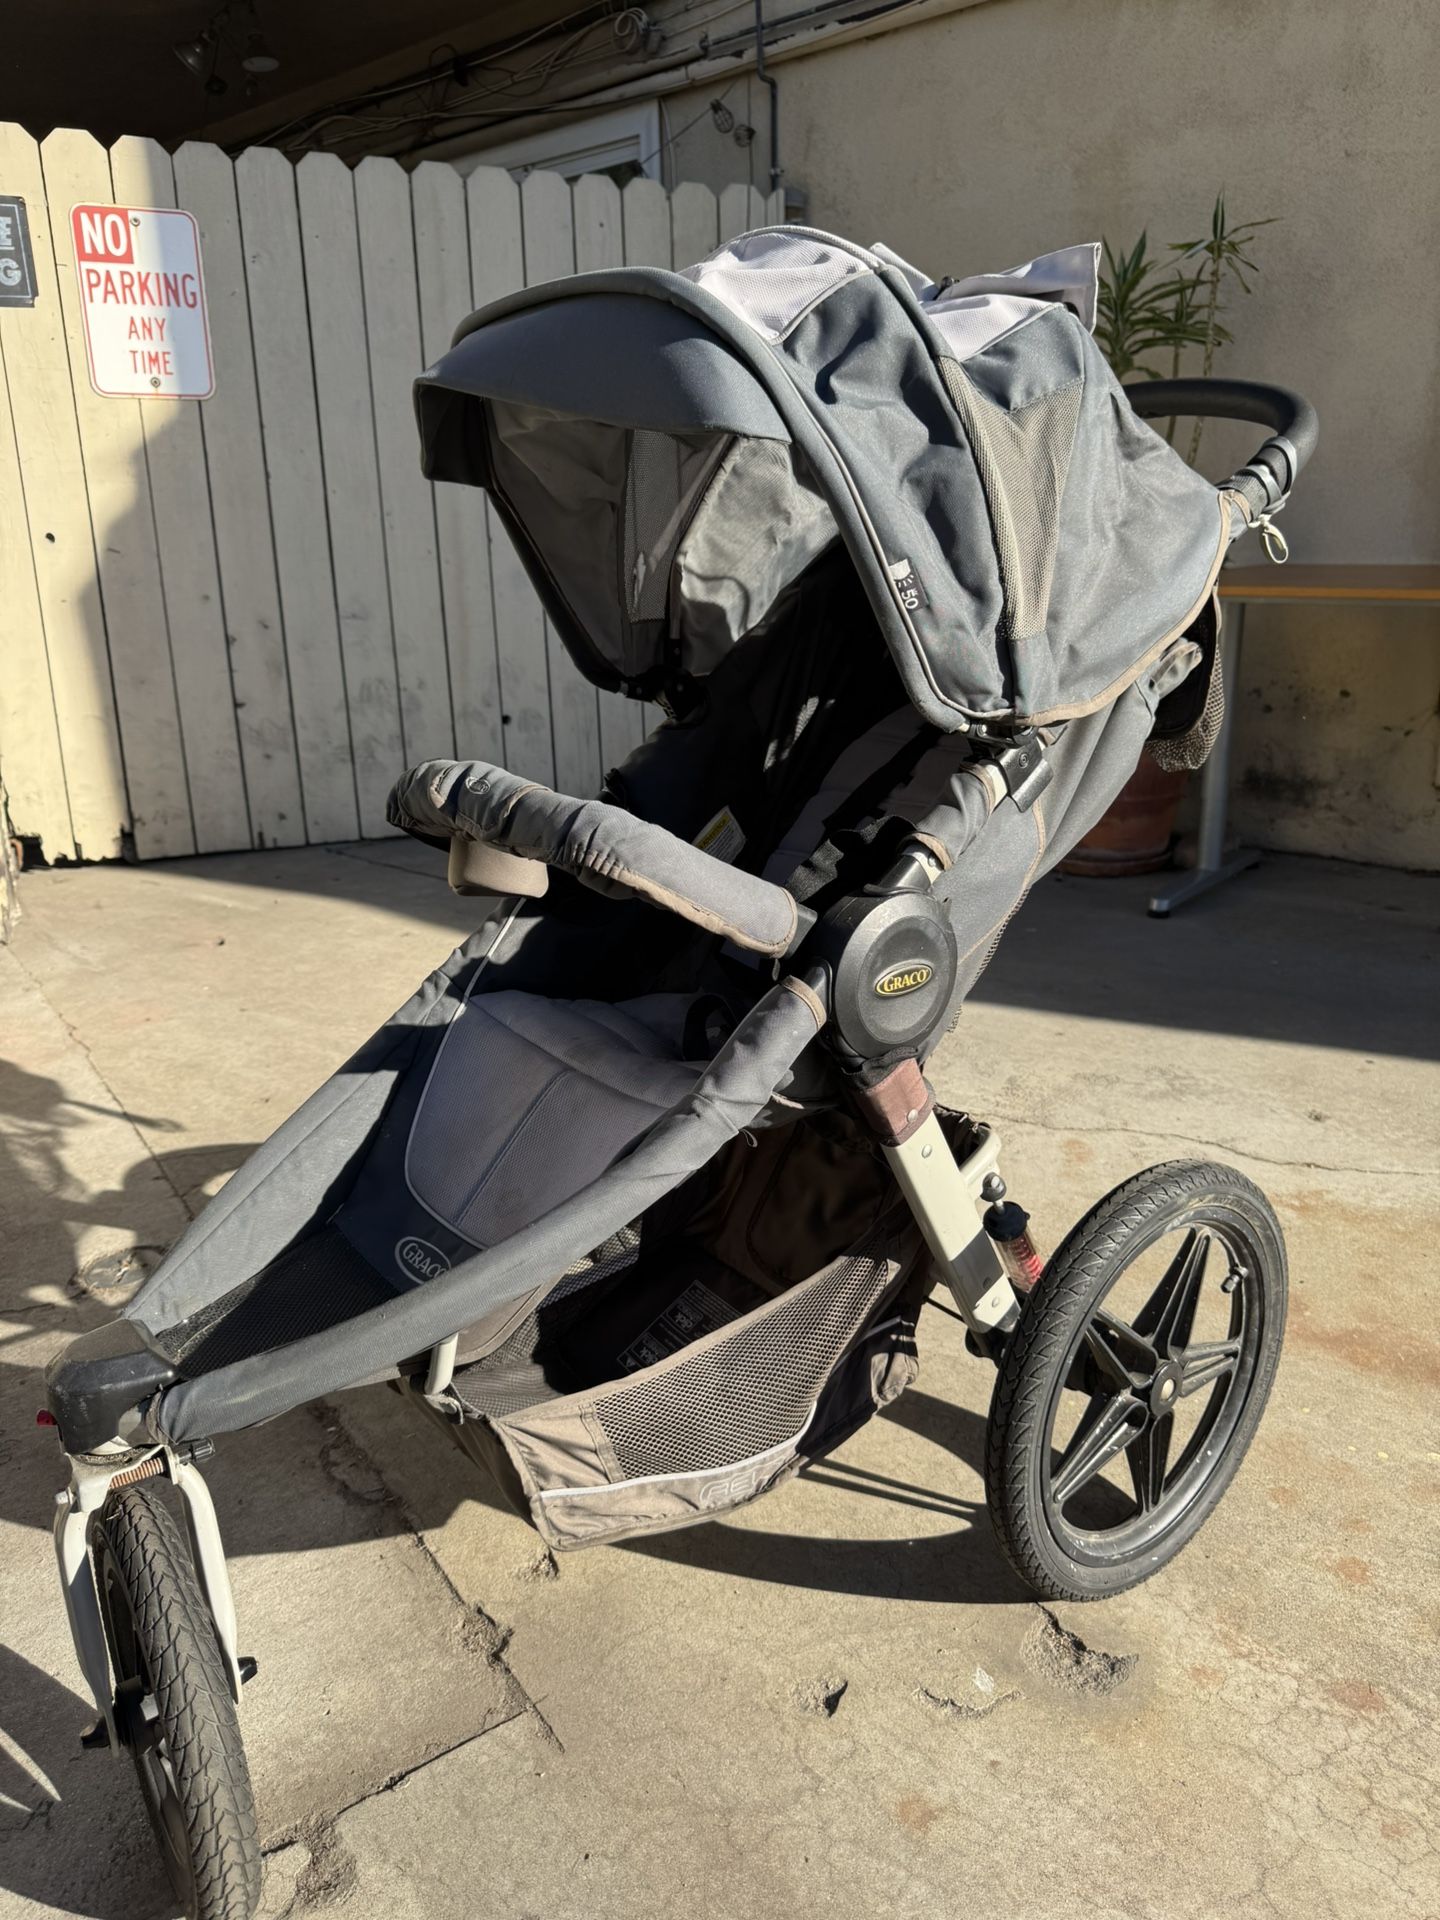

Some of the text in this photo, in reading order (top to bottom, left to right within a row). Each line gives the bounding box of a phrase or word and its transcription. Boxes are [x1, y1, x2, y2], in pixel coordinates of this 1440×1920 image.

[79, 212, 128, 256] NO
[86, 268, 198, 309] PARKING
[128, 316, 166, 342] ANY
[129, 350, 174, 375] TIME
[883, 969, 927, 992] GRACO
